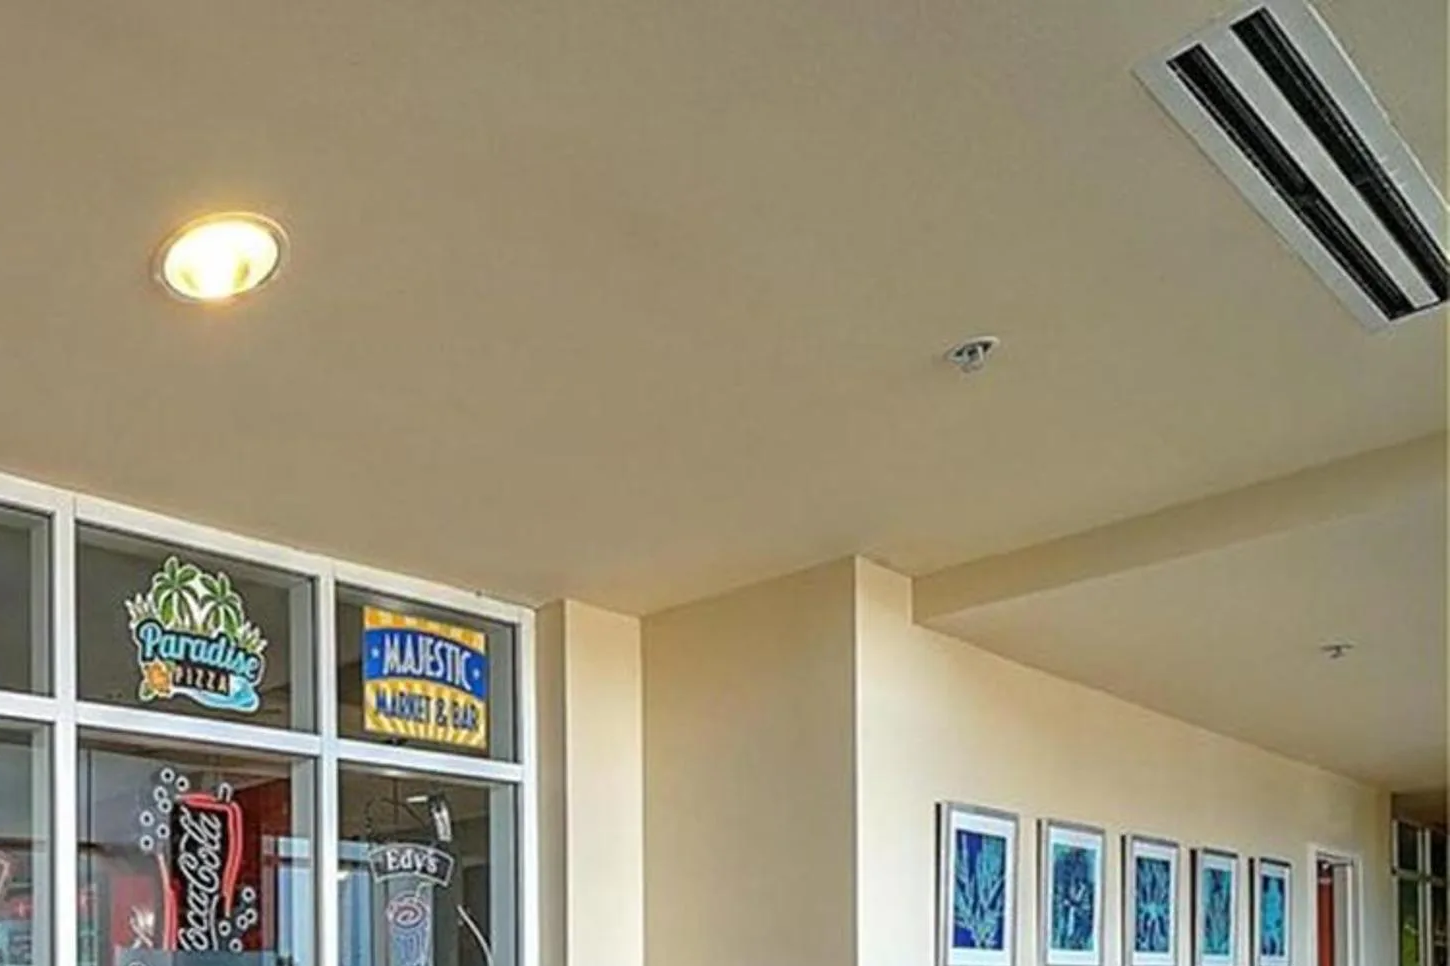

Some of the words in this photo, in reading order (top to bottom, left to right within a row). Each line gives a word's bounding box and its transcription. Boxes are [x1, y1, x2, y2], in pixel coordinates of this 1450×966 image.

[138, 621, 260, 681] Paradise
[175, 665, 228, 692] PIZZA
[382, 632, 472, 691] MAJESTIC
